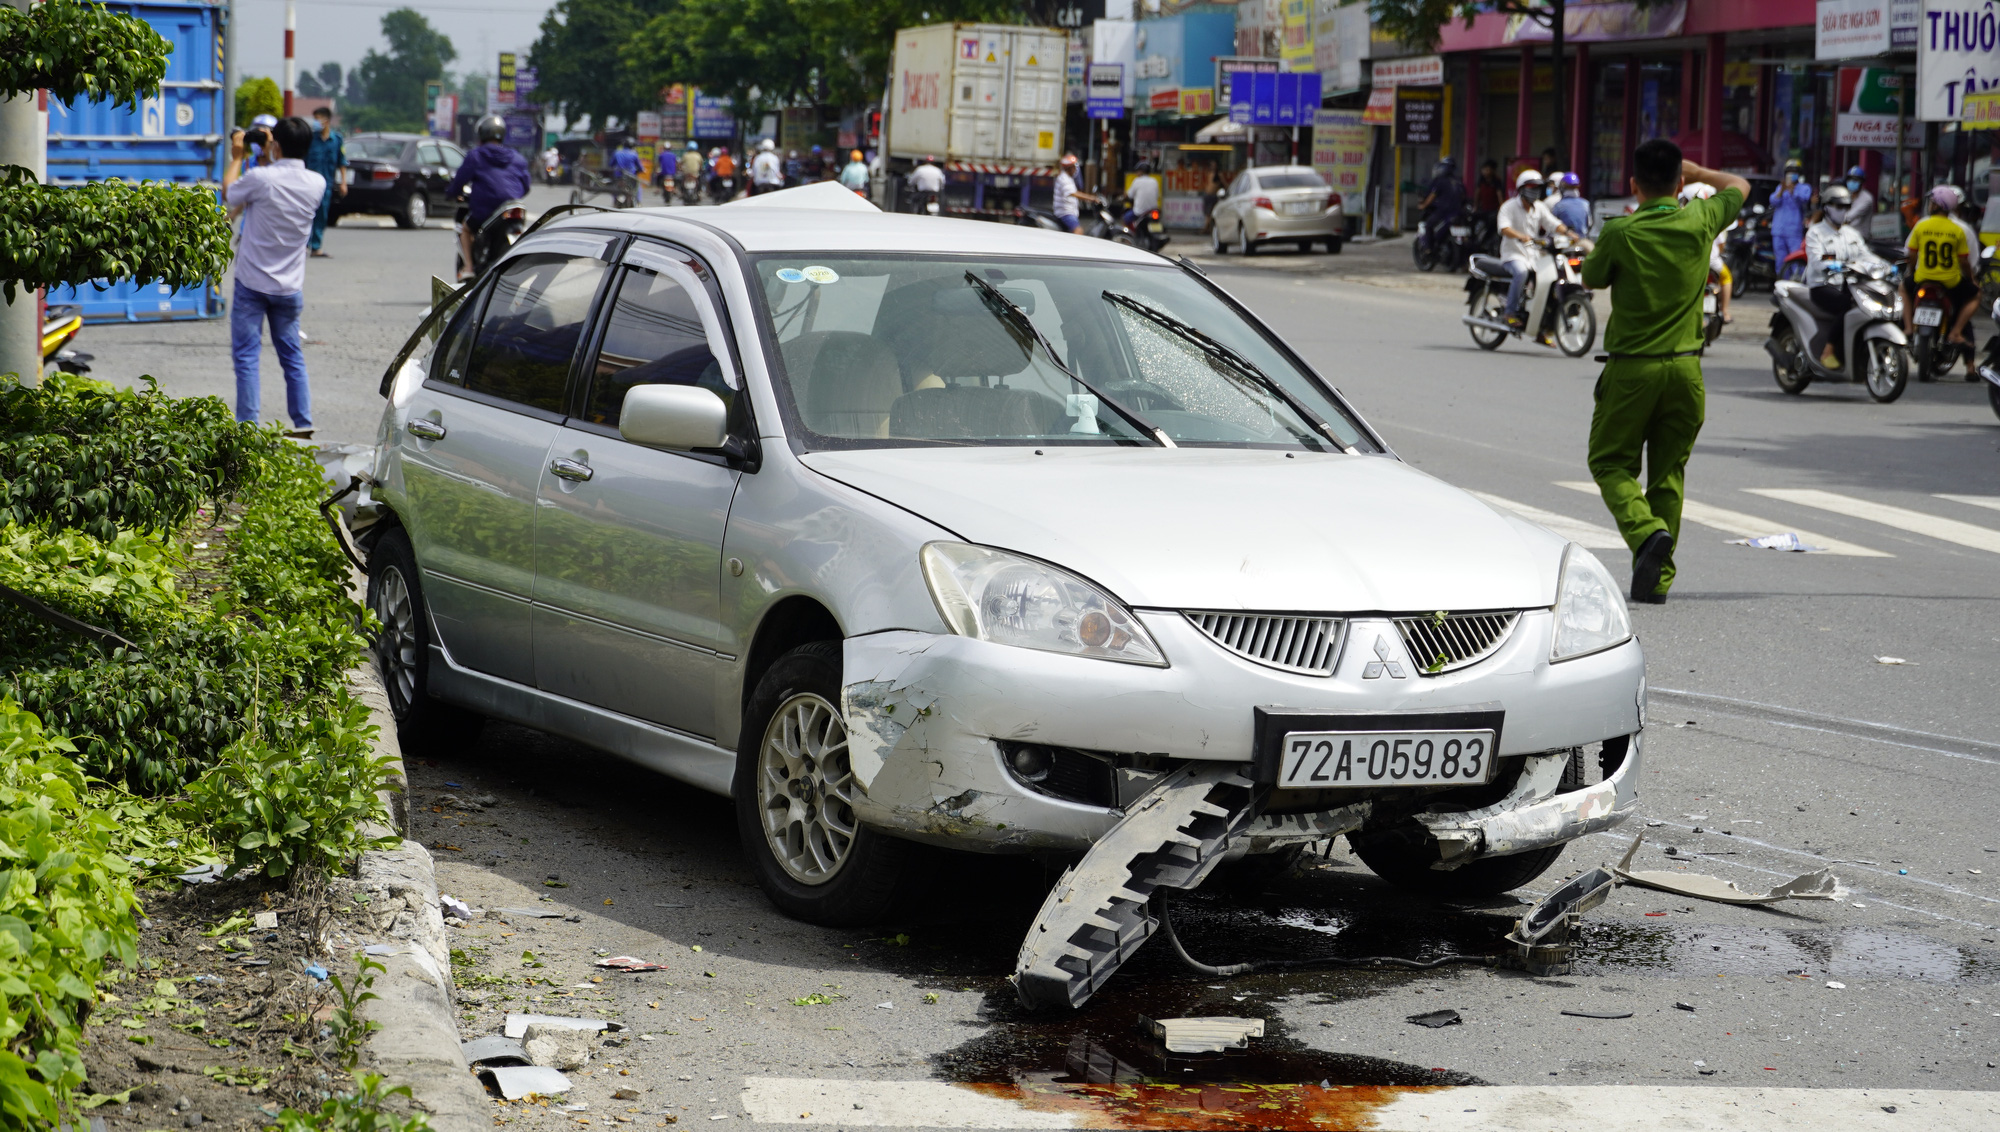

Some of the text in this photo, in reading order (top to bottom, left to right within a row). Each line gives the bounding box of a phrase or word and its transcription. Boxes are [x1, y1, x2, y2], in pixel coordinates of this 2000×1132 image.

[1849, 12, 1864, 30] NGA
[1926, 1, 2000, 53] THUÔ
[1853, 121, 1881, 133] NGA
[1924, 240, 1954, 270] 69
[1287, 738, 1485, 782] 72A-059.83
